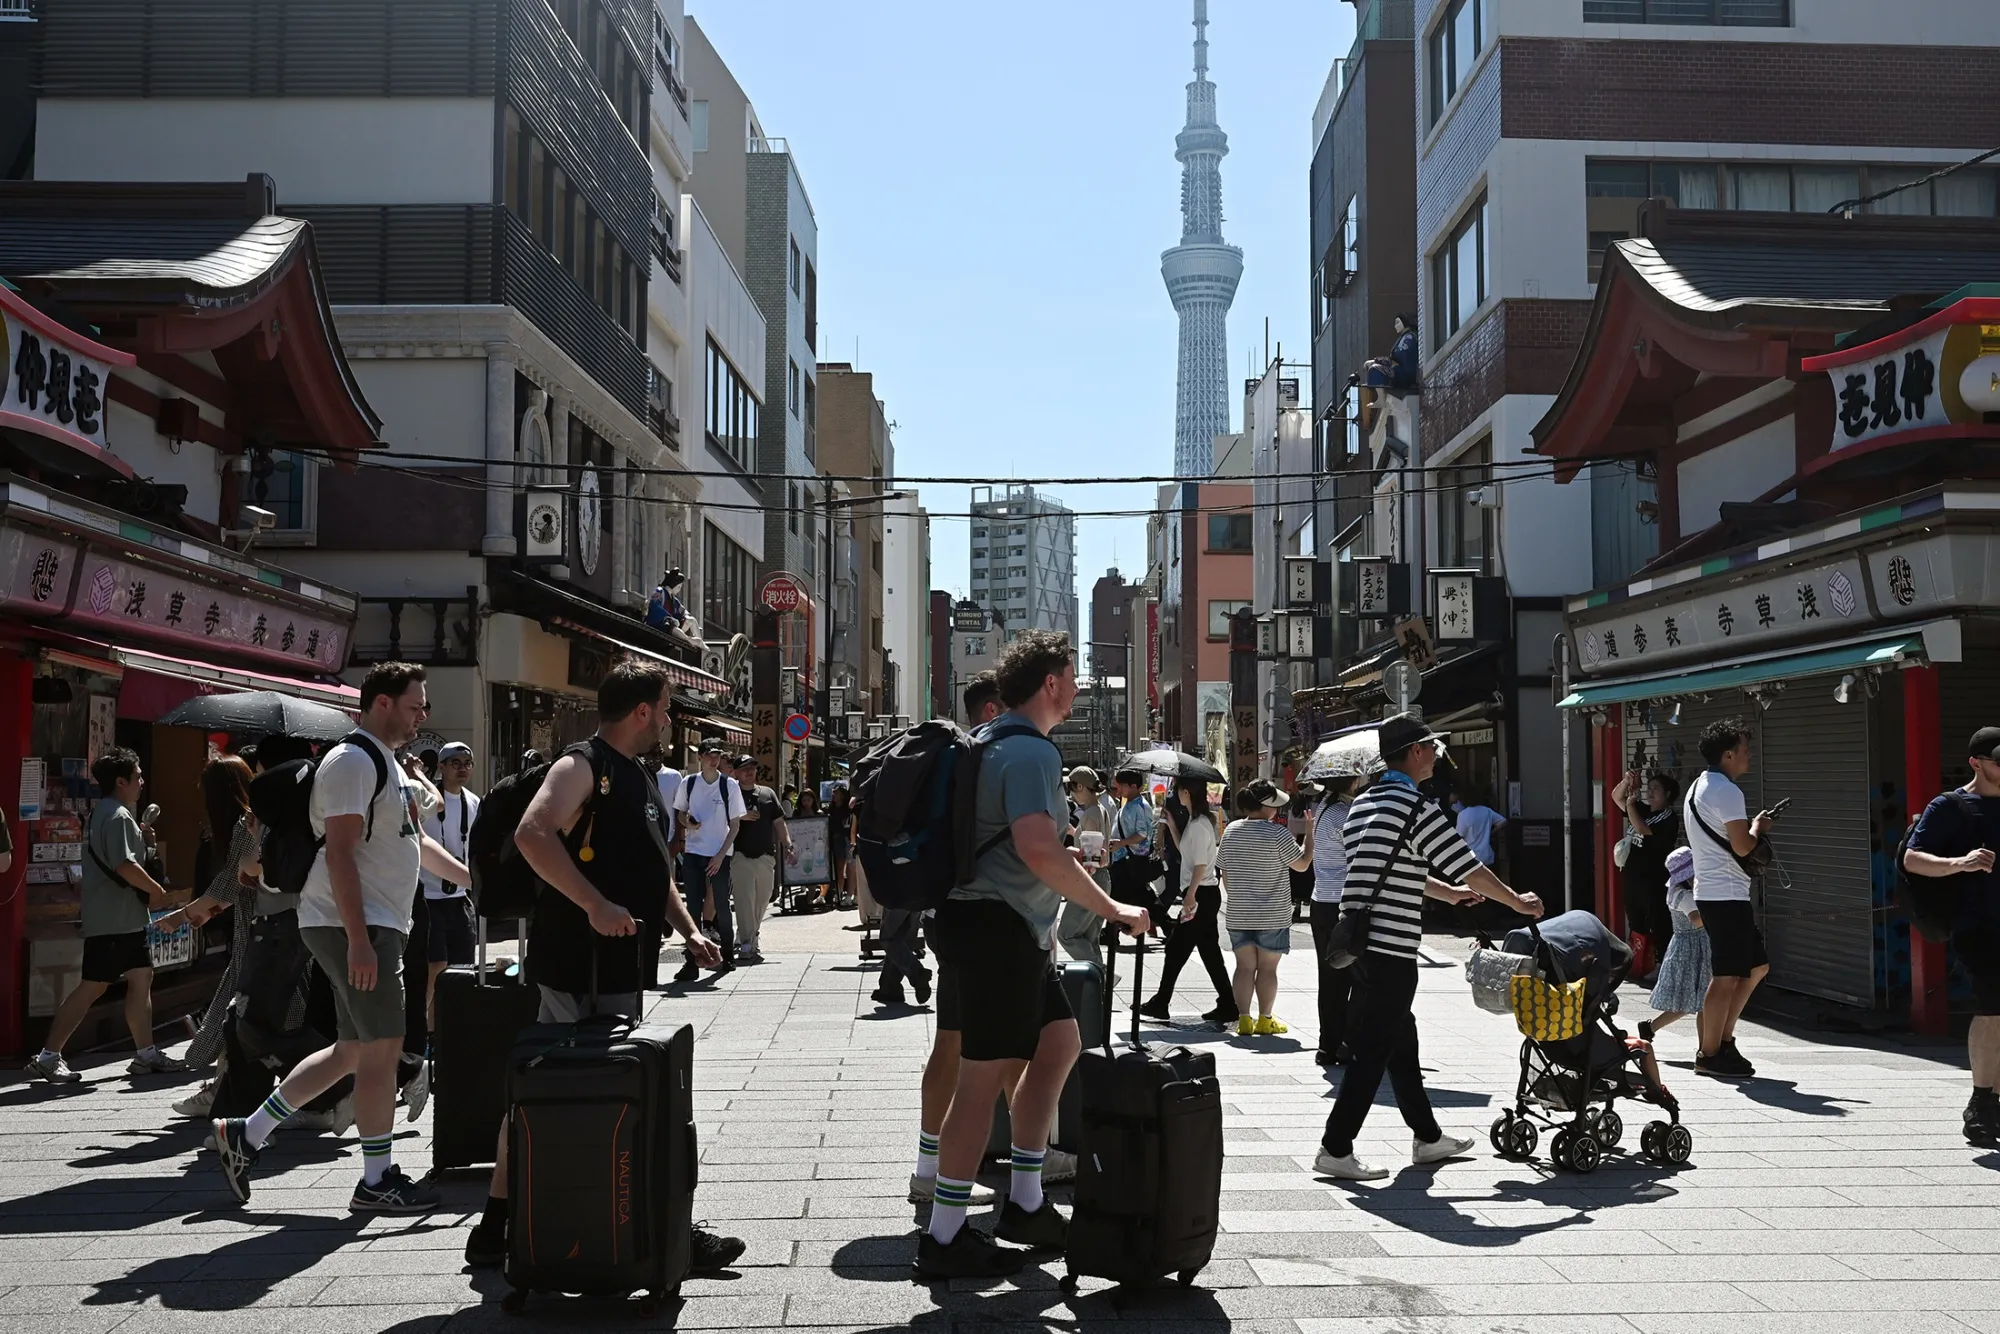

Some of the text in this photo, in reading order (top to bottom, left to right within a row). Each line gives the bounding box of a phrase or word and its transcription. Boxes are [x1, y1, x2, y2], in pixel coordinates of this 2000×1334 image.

[765, 589, 797, 605] 消火栓
[1296, 565, 1306, 599] にしだ
[1375, 576, 1385, 601] らめん
[1460, 581, 1469, 634] おいもやさん
[754, 709, 774, 782] 伝法院
[1236, 711, 1256, 783] 伝法院
[618, 1150, 630, 1225] NAUTICA
